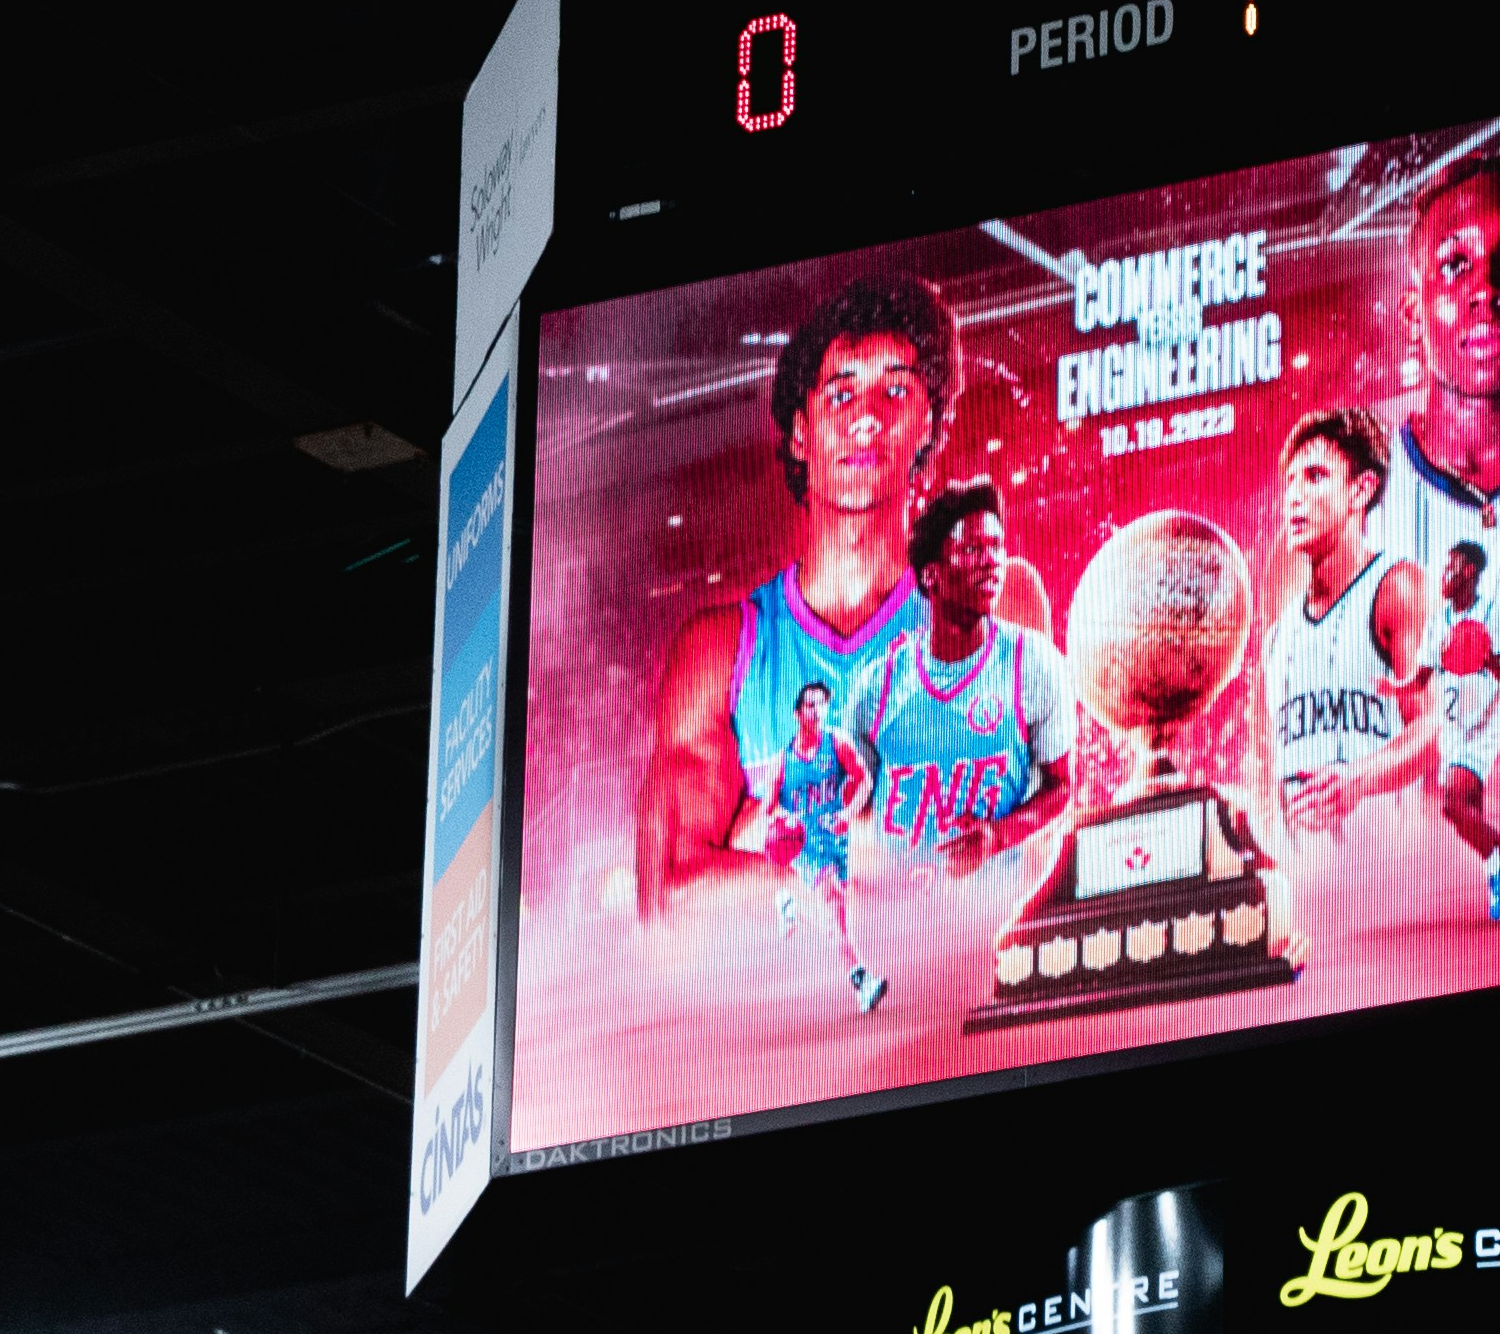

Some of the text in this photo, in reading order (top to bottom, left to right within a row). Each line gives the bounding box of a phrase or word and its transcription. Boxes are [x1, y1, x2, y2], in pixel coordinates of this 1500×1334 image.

[736, 11, 798, 133] 0
[1075, 229, 1267, 334] COMMERCE
[1056, 312, 1282, 423] ENGINEERING
[446, 459, 505, 591] UNIFORMS
[440, 704, 494, 824] SERVICES
[445, 655, 494, 765] FACILITY
[433, 900, 466, 980] FIRST
[443, 915, 487, 1016] SAFETY
[525, 1117, 732, 1172] DAKTRONICS
[1280, 1191, 1465, 1308] Leon's
